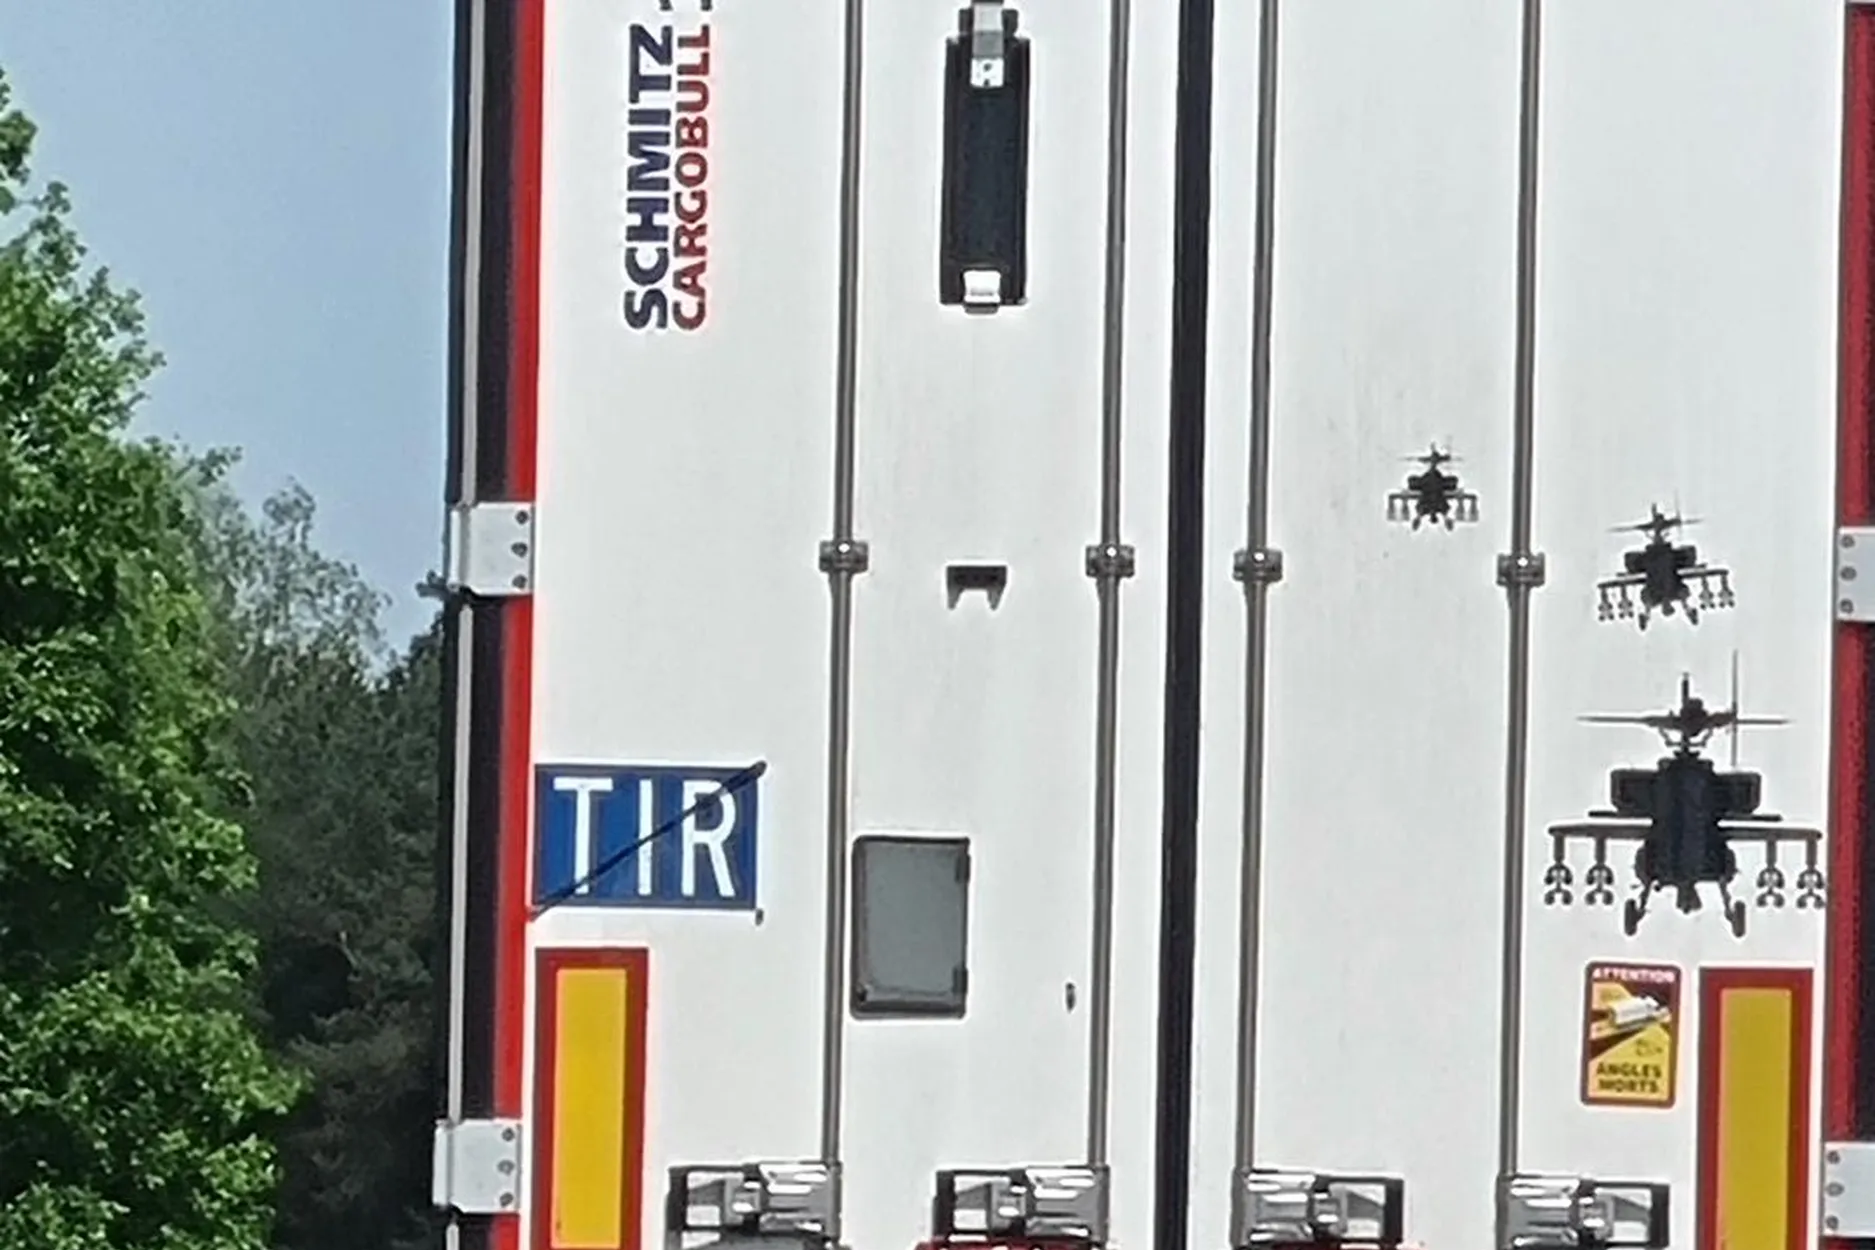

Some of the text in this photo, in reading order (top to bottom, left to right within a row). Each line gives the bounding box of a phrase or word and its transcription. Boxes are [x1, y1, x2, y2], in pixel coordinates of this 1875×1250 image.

[624, 23, 673, 330] SCHMITZ
[671, 24, 710, 331] CARGOBULL
[553, 777, 736, 897] TIR
[1592, 967, 1676, 983] ATTENTION
[1596, 1062, 1662, 1078] ANGLES
[1598, 1078, 1659, 1093] MORTS
